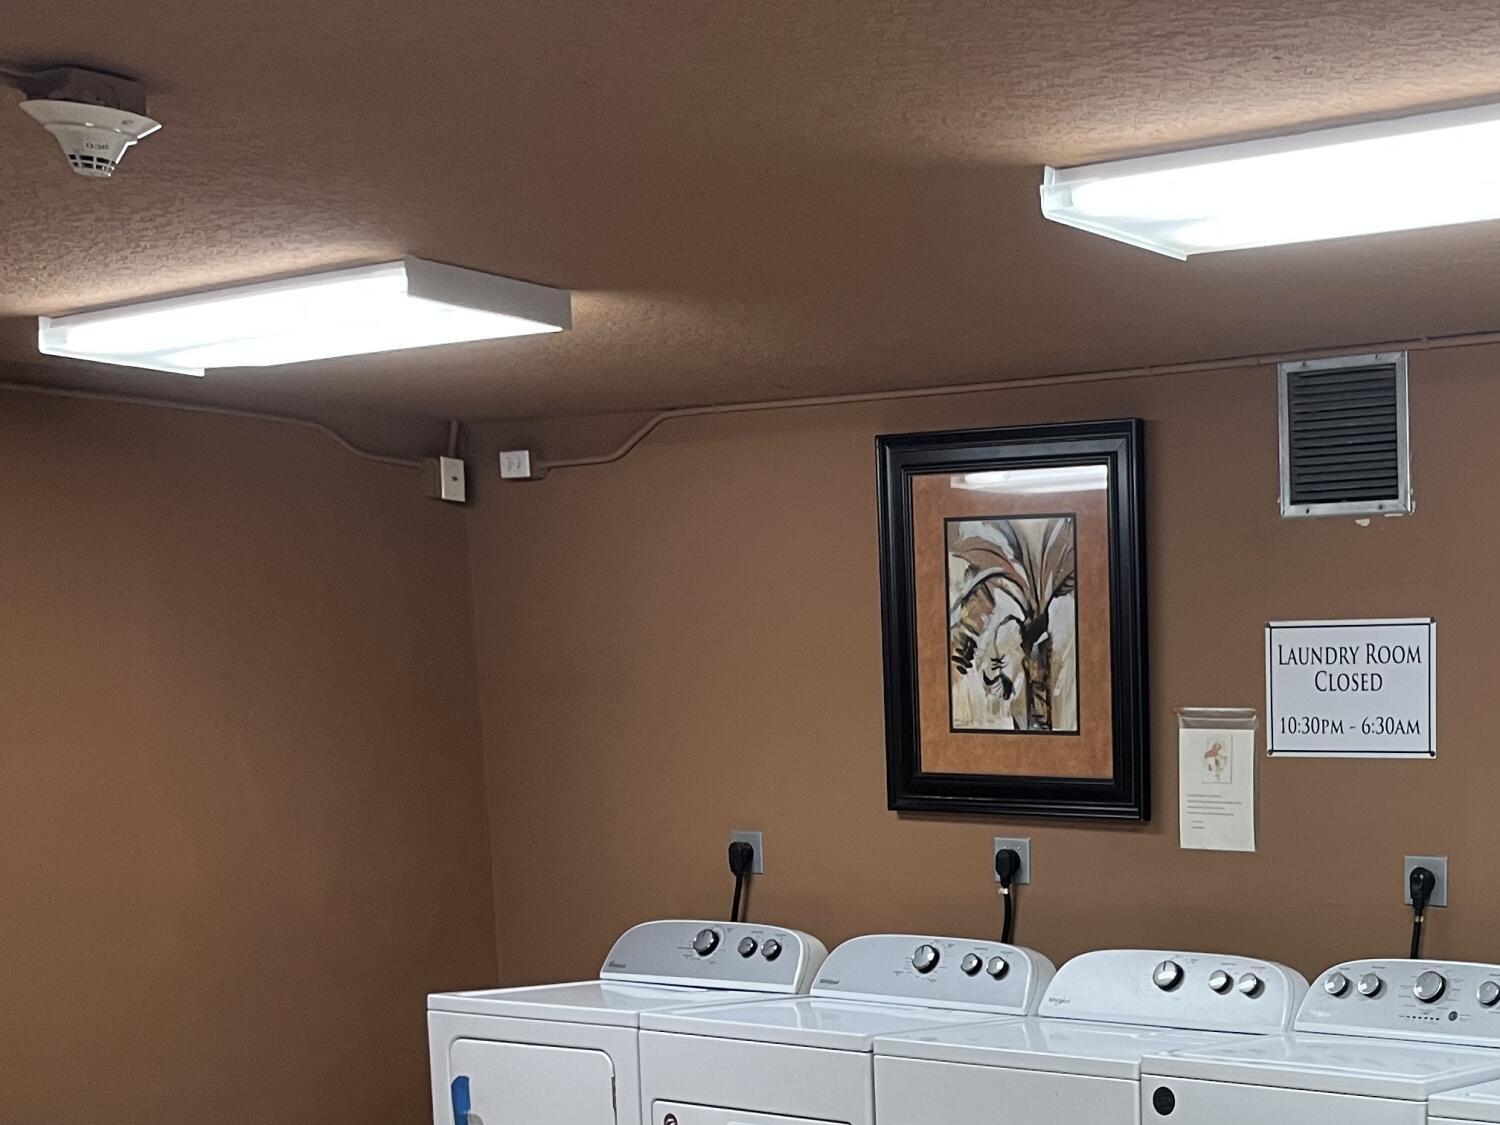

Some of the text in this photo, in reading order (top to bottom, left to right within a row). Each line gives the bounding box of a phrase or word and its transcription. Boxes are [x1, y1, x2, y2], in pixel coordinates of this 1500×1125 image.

[1278, 643, 1422, 665] LAUNDRY ROOM
[1314, 670, 1383, 692] CLOSED
[1280, 716, 1344, 735] 10:30PM
[1361, 716, 1421, 735] 6:30AM
